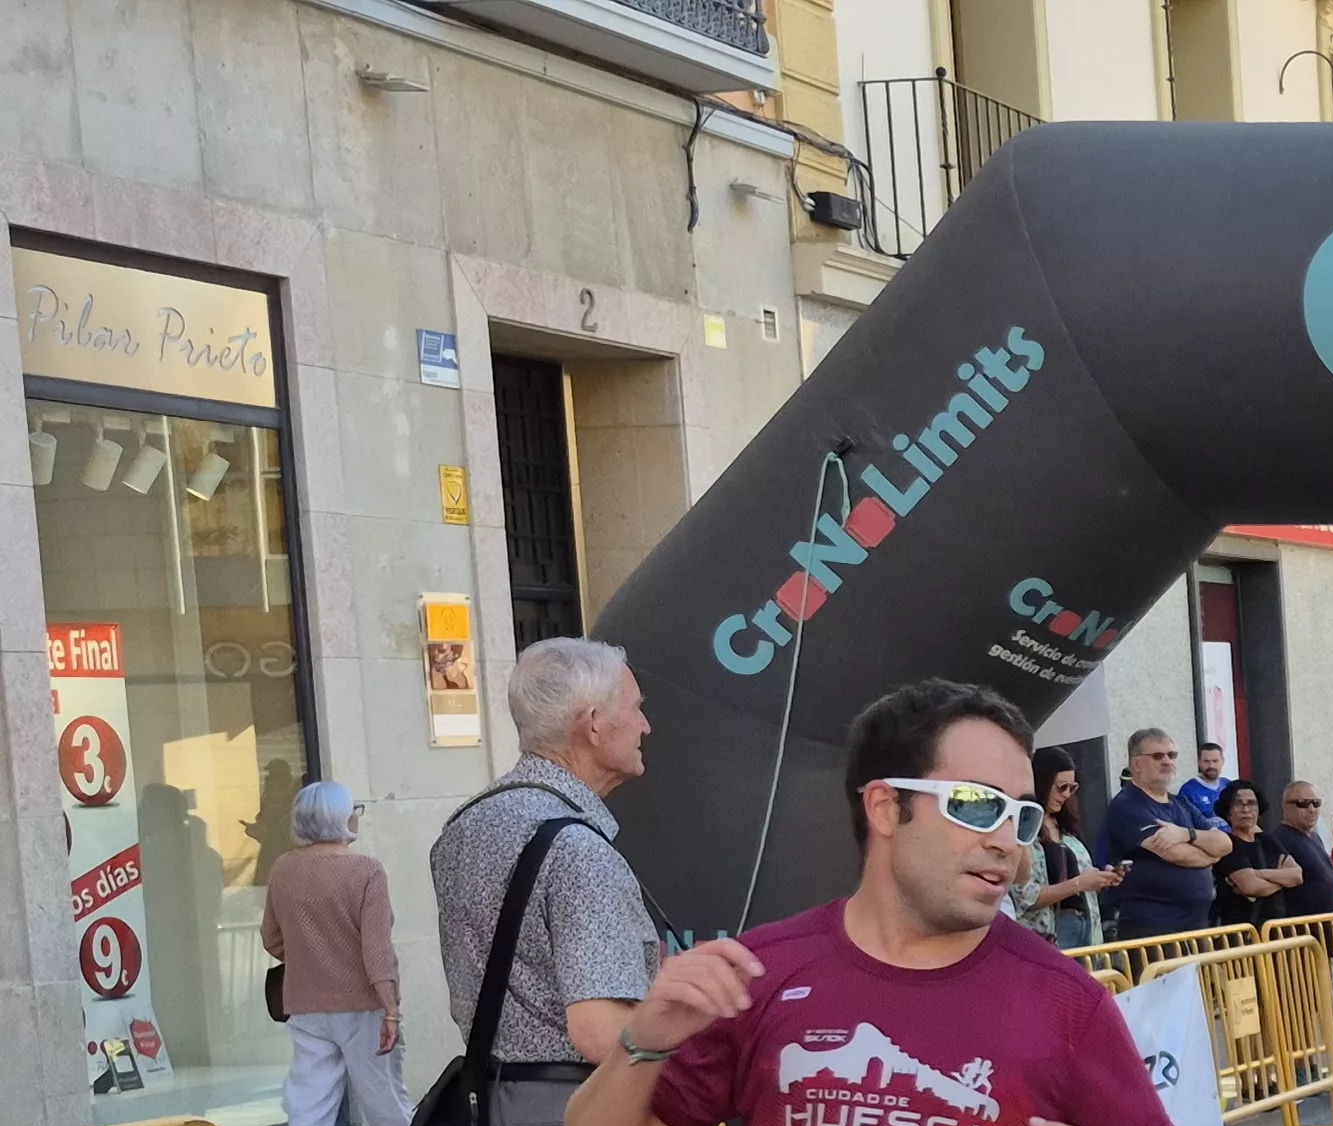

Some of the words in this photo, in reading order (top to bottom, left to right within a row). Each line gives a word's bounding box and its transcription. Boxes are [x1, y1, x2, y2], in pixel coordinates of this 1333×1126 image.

[580, 288, 598, 332] 2
[156, 306, 267, 377] Prieto
[68, 629, 120, 672] Final
[96, 859, 140, 898] días
[805, 1088, 879, 1105] CIUDAD
[883, 1096, 909, 1107] DE
